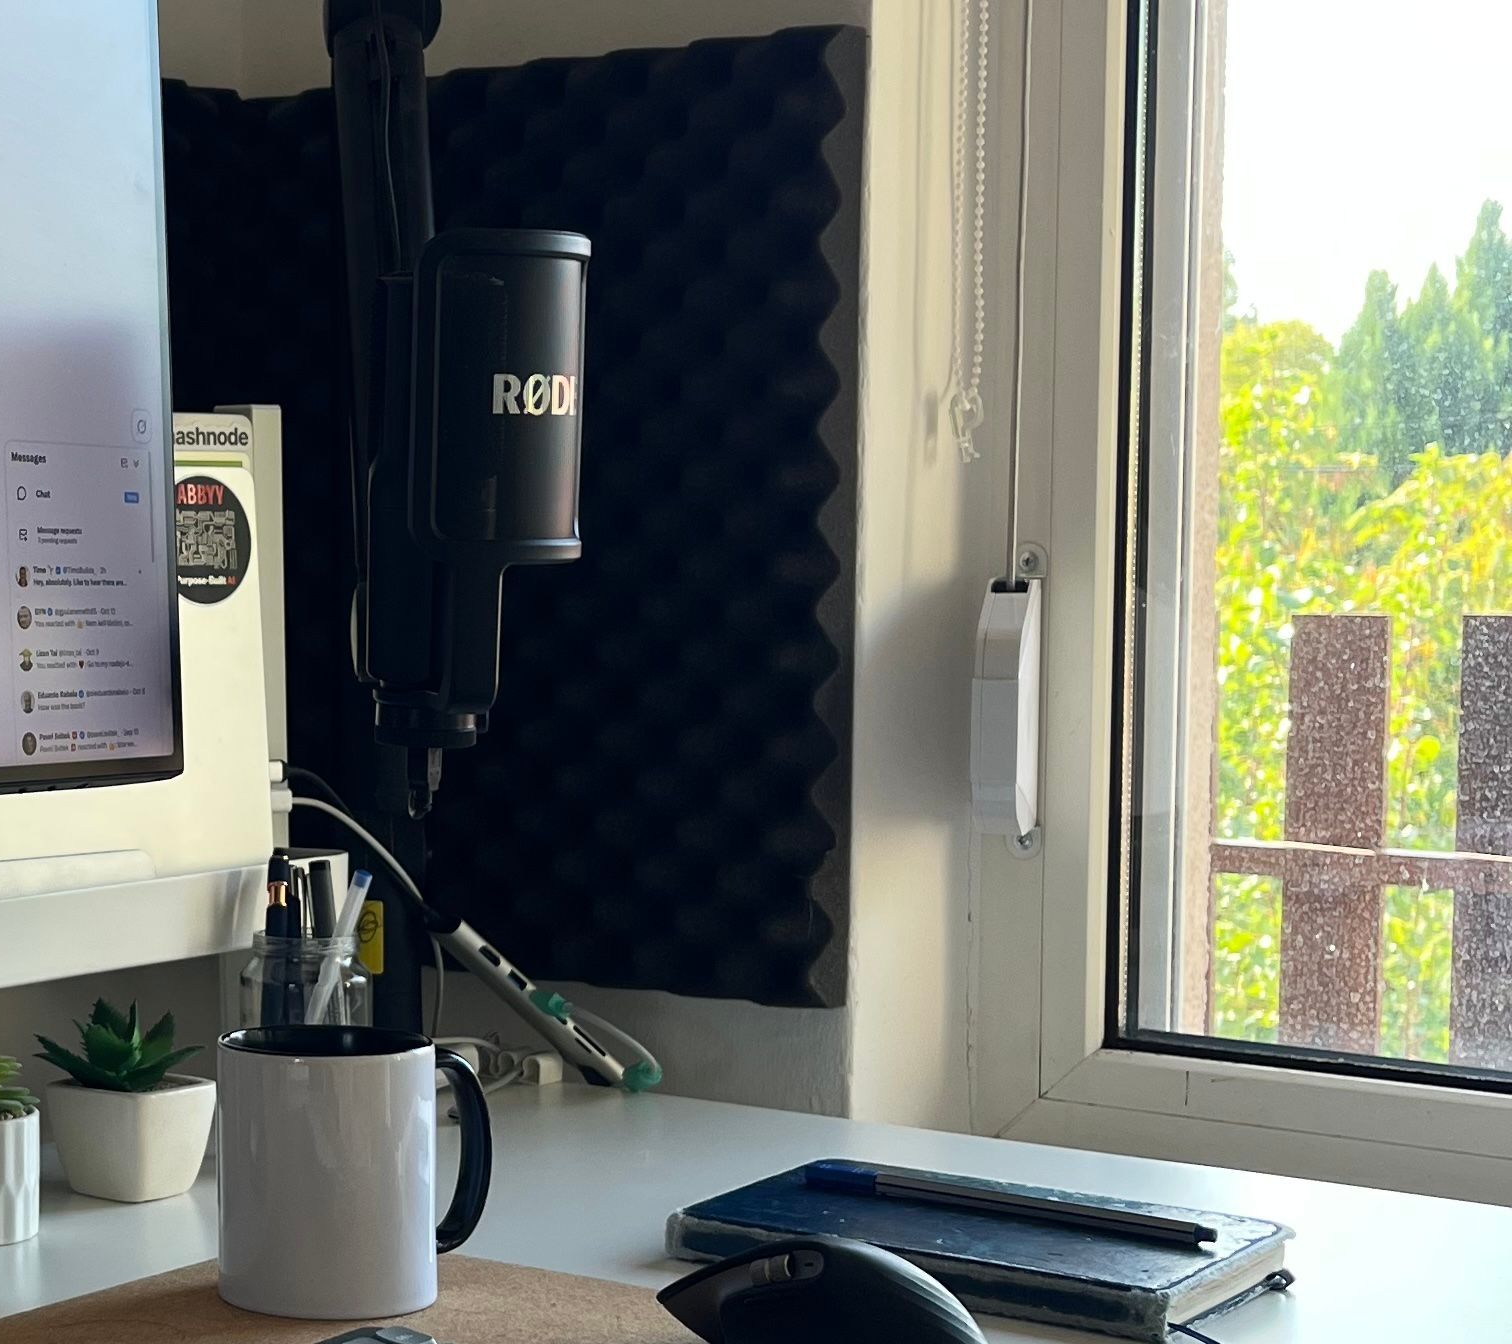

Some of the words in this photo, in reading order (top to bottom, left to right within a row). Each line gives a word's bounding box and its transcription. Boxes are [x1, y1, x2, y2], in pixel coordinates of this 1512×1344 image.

[173, 427, 249, 446] ashnode
[11, 452, 46, 465] Messages
[36, 490, 51, 498] Chat
[177, 483, 224, 505] ABBYY
